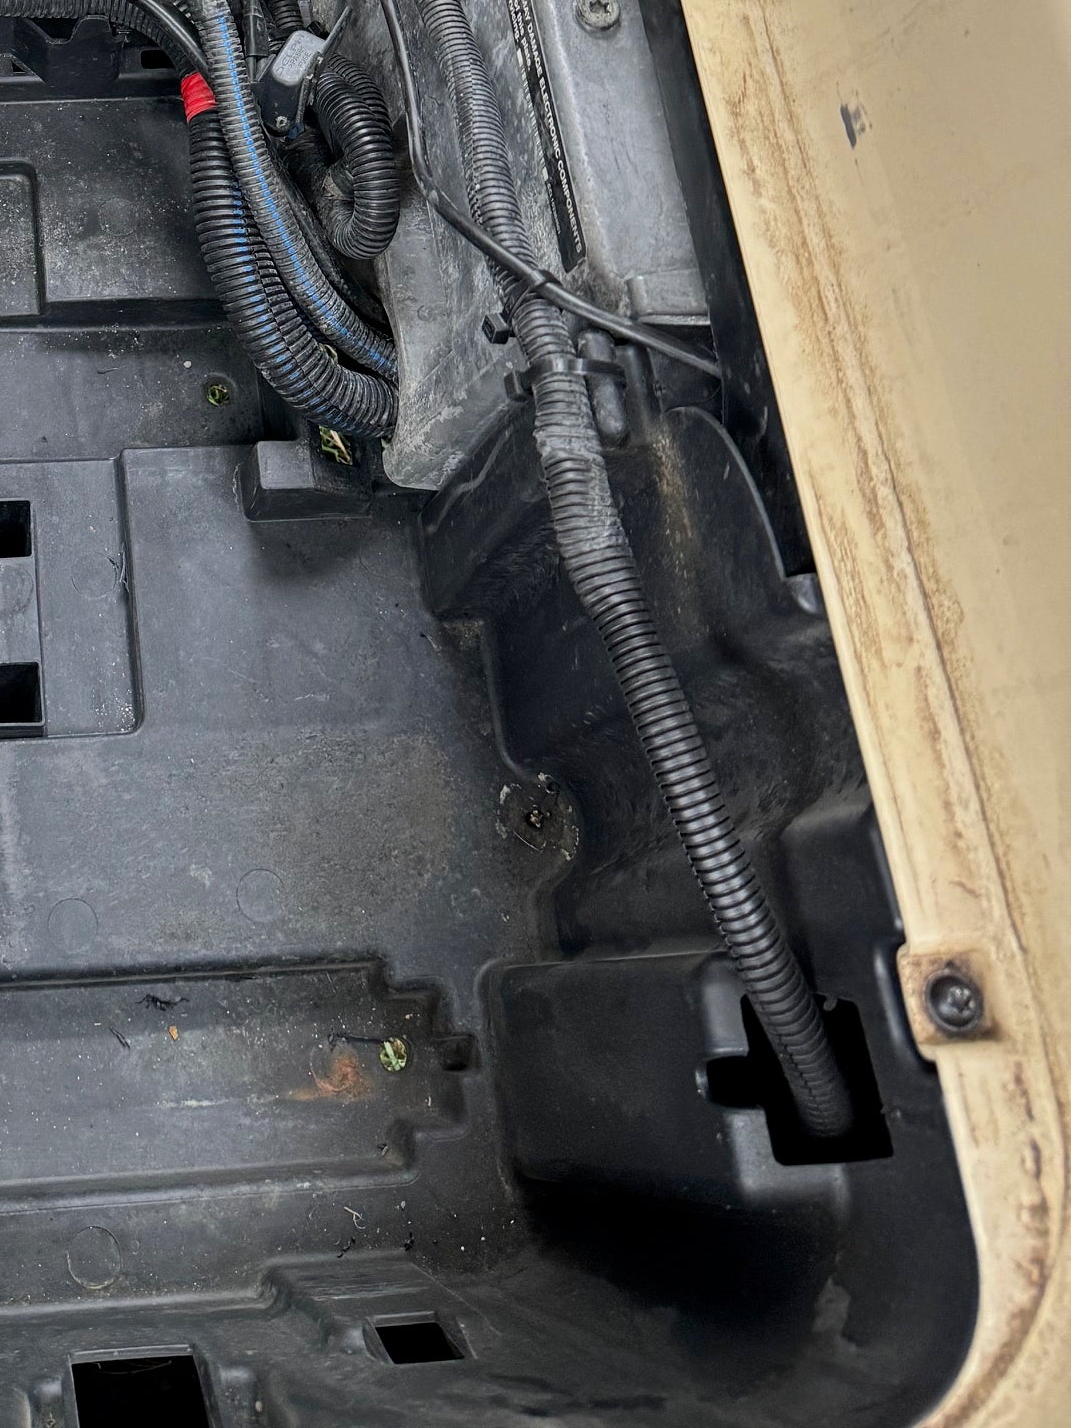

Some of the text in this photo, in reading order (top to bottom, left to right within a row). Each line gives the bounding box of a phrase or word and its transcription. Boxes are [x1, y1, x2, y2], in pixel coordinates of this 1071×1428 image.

[526, 21, 543, 78] DAMAGE
[538, 76, 561, 160] ELECTRONIC
[556, 158, 583, 254] COMPONENTS
